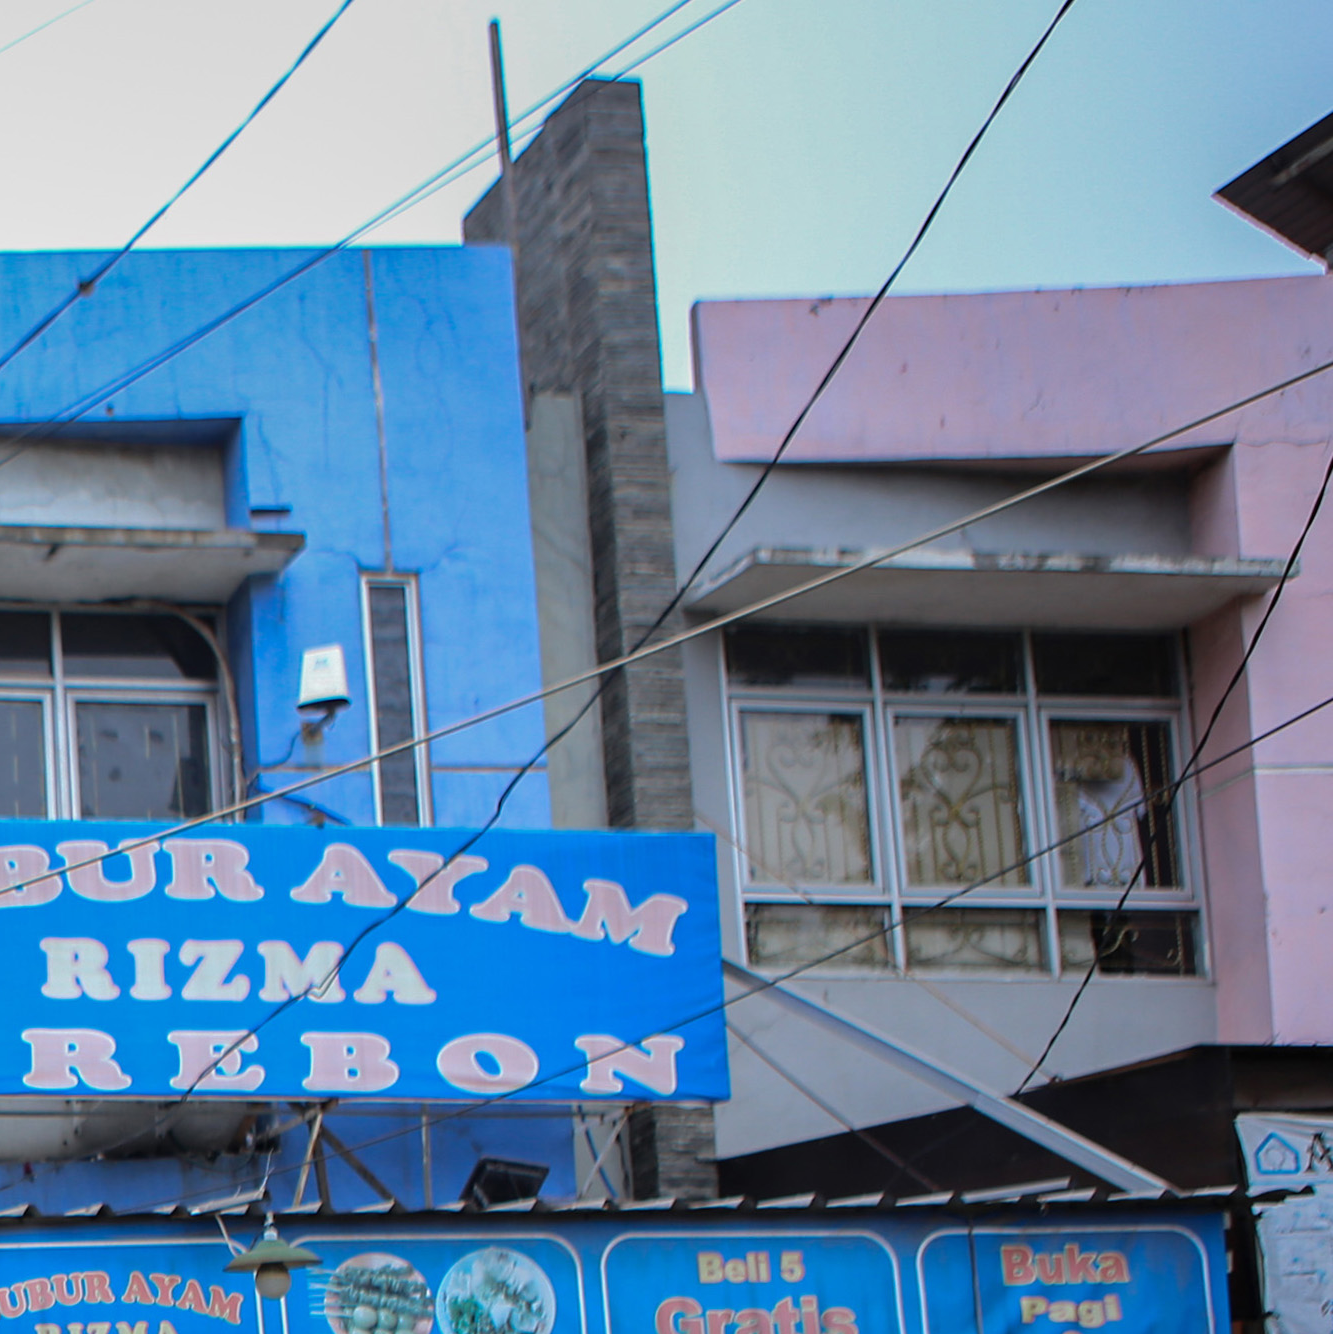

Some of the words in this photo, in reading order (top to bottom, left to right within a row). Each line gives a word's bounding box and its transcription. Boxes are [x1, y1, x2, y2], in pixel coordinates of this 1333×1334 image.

[290, 844, 688, 957] AYAM
[40, 936, 437, 1004] RIZMA
[697, 1251, 771, 1284] Beli
[780, 1251, 806, 1283] 5
[999, 1243, 1132, 1287] Buka
[121, 1270, 245, 1325] AYAM
[1020, 1294, 1122, 1328] Pagi
